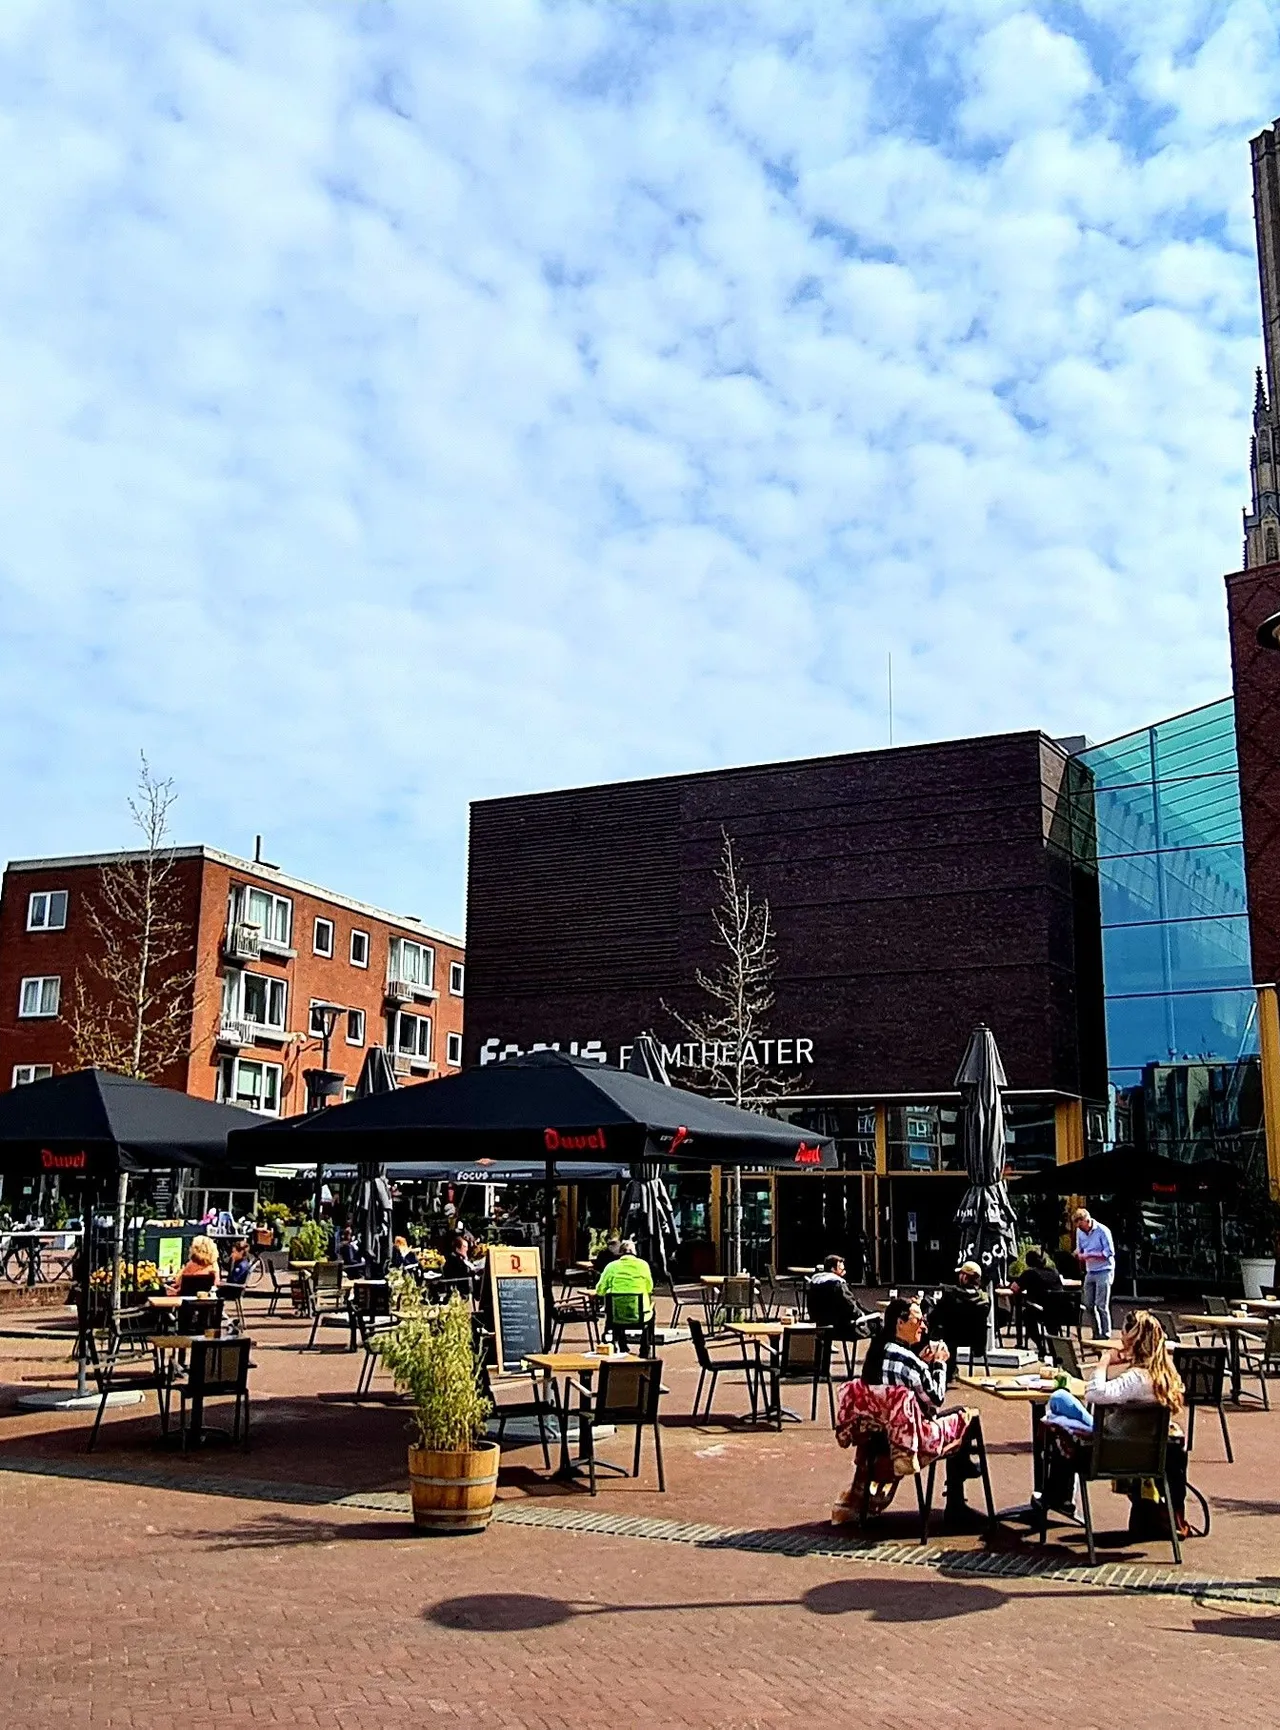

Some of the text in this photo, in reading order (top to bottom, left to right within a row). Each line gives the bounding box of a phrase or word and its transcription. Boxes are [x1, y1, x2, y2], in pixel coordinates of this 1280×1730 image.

[480, 1038, 814, 1070] FOS FMTHEATER
[544, 1127, 606, 1150] Duvel
[41, 1149, 85, 1168] Duvel
[457, 1171, 489, 1181] FOCUS
